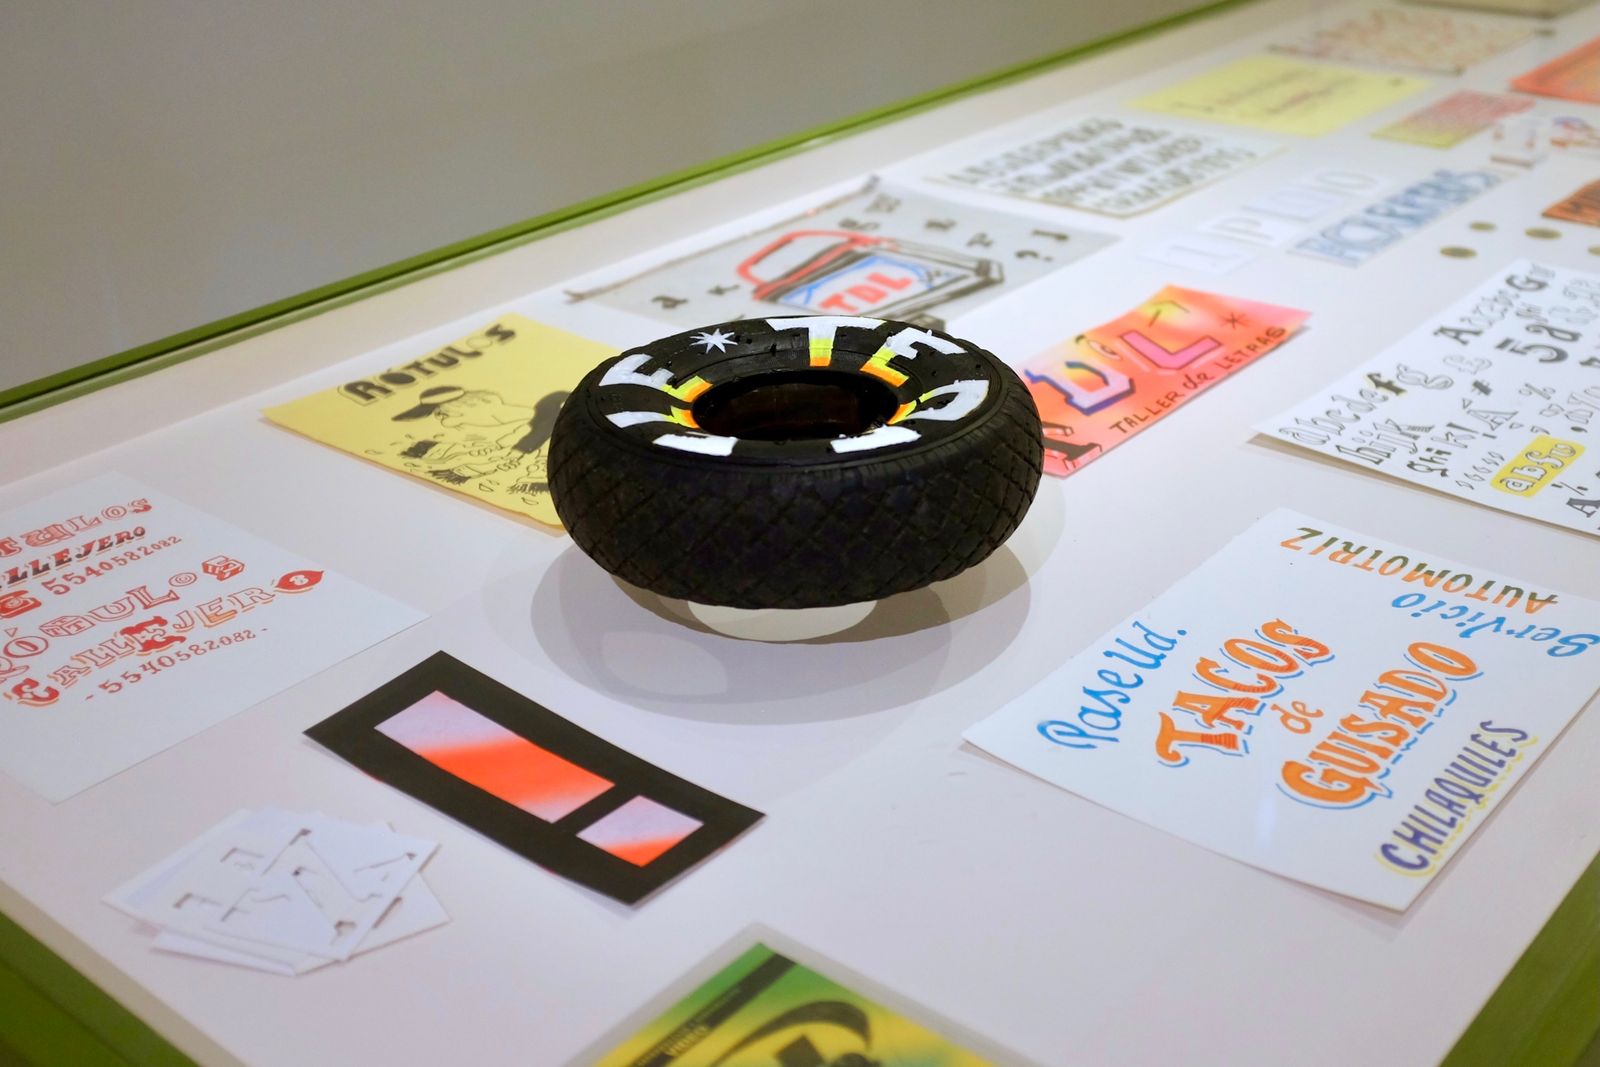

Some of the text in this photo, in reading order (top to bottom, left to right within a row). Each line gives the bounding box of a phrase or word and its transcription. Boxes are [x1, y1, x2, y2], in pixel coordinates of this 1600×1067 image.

[337, 323, 517, 406] RÓTULOS
[1109, 325, 1288, 435] TALLER de LETRAS
[0, 526, 146, 592] LLEJERO
[41, 535, 183, 596] 5540582082
[1280, 527, 1559, 614] AUTOMOTRIZ
[3, 569, 325, 708] CALLEJERO
[1037, 668, 1144, 749] Pase
[1154, 617, 1334, 769] TACOS
[1269, 700, 1324, 735] de
[1276, 641, 1484, 811] GUISADO
[1377, 718, 1532, 875] CHILAQUILES
